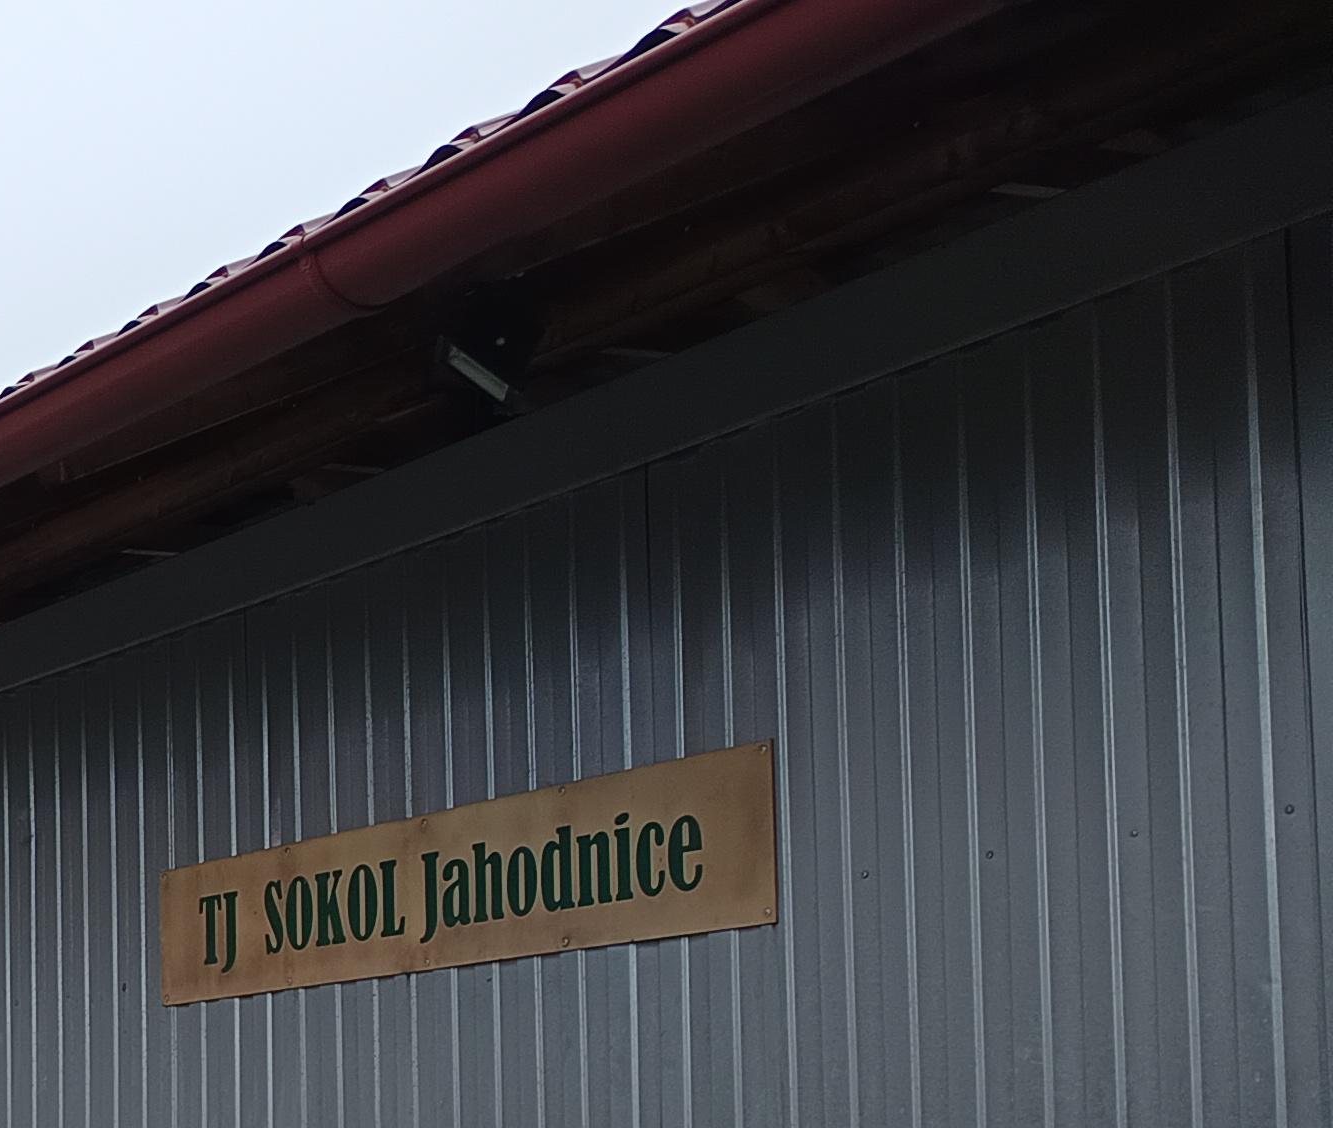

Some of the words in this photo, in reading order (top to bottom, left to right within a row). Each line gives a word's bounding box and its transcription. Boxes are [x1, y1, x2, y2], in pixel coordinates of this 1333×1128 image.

[199, 891, 239, 973] TJ
[264, 859, 405, 956] SOKOL
[420, 812, 704, 944] Jahodnice
